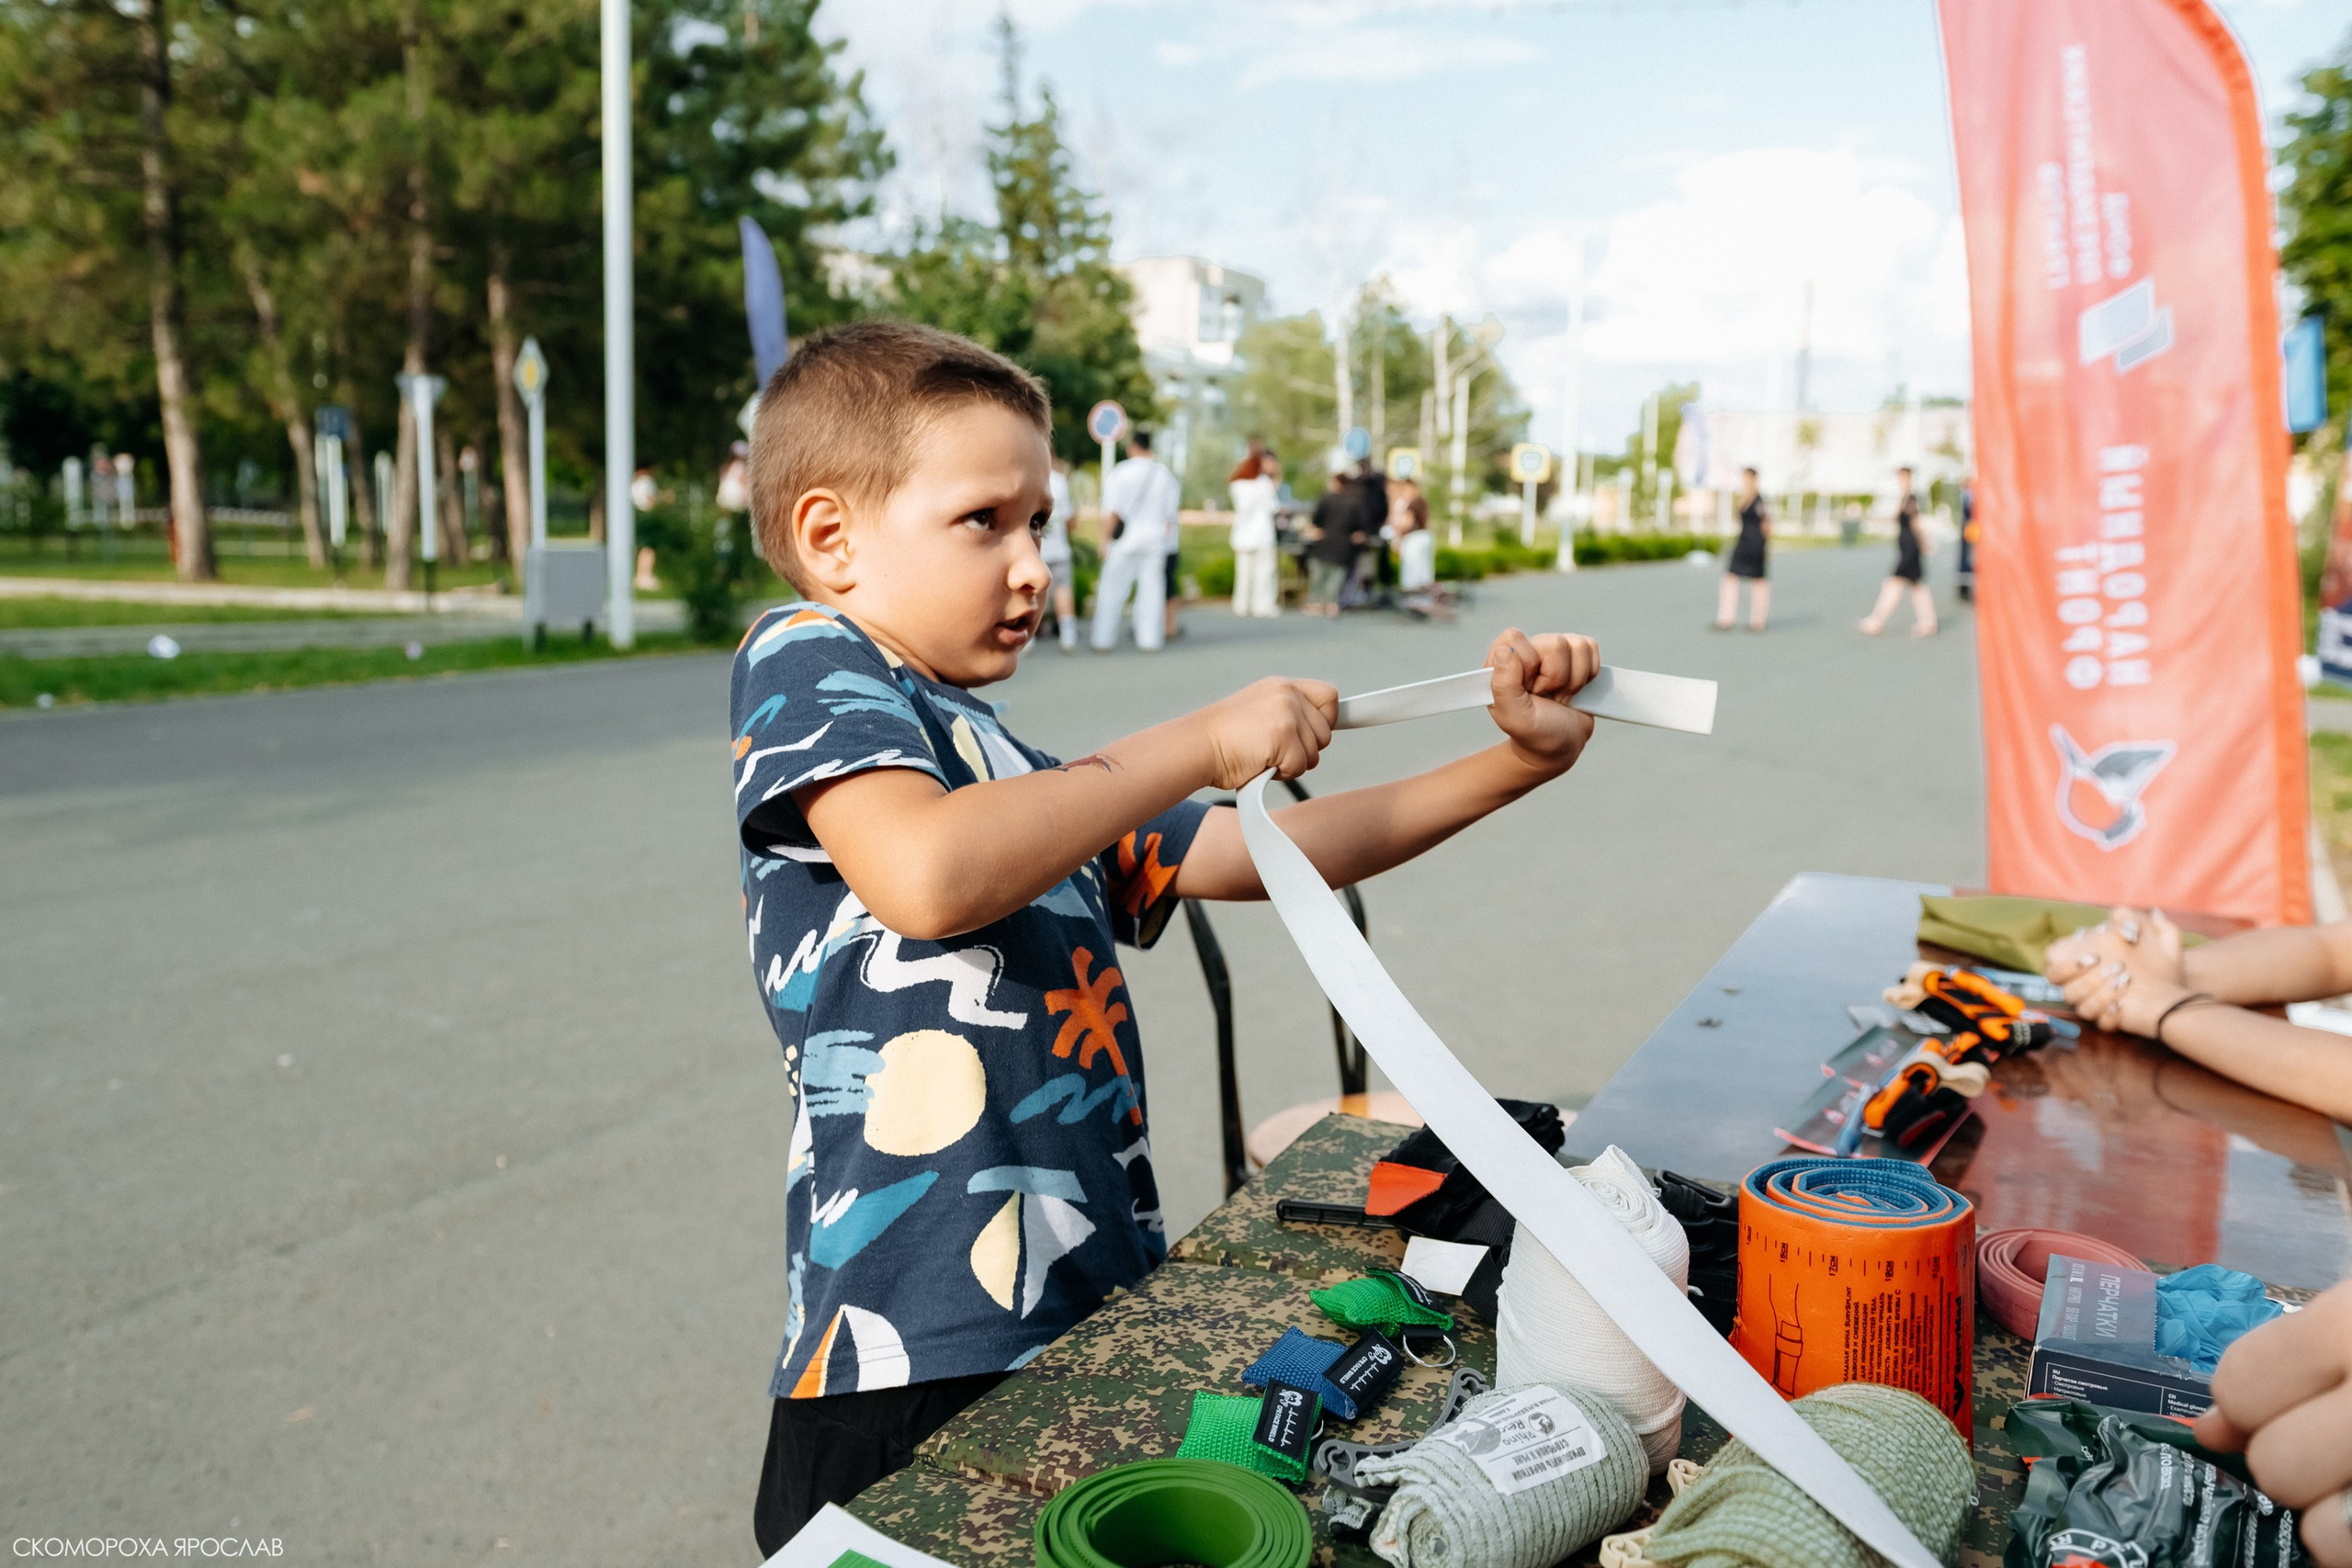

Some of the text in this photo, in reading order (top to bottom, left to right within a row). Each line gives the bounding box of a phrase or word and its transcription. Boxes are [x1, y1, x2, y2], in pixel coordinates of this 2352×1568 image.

[2094, 1274, 2121, 1339] ПЕРЧАТКИ
[1339, 1370, 1354, 1384] SHIELD
[2052, 1374, 2109, 1392] Перчатки смотровые
[2167, 1399, 2188, 1407] Medical
[1268, 1425, 1278, 1442] SHIELD
[1501, 1428, 1536, 1449] Rhino
[1534, 1438, 1568, 1460] СТОРОНОЙ
[1510, 1446, 1586, 1483] ПРИЛОЖИТЬ ОБРАТНОЙ
[1511, 1451, 1531, 1466] РАНЕ
